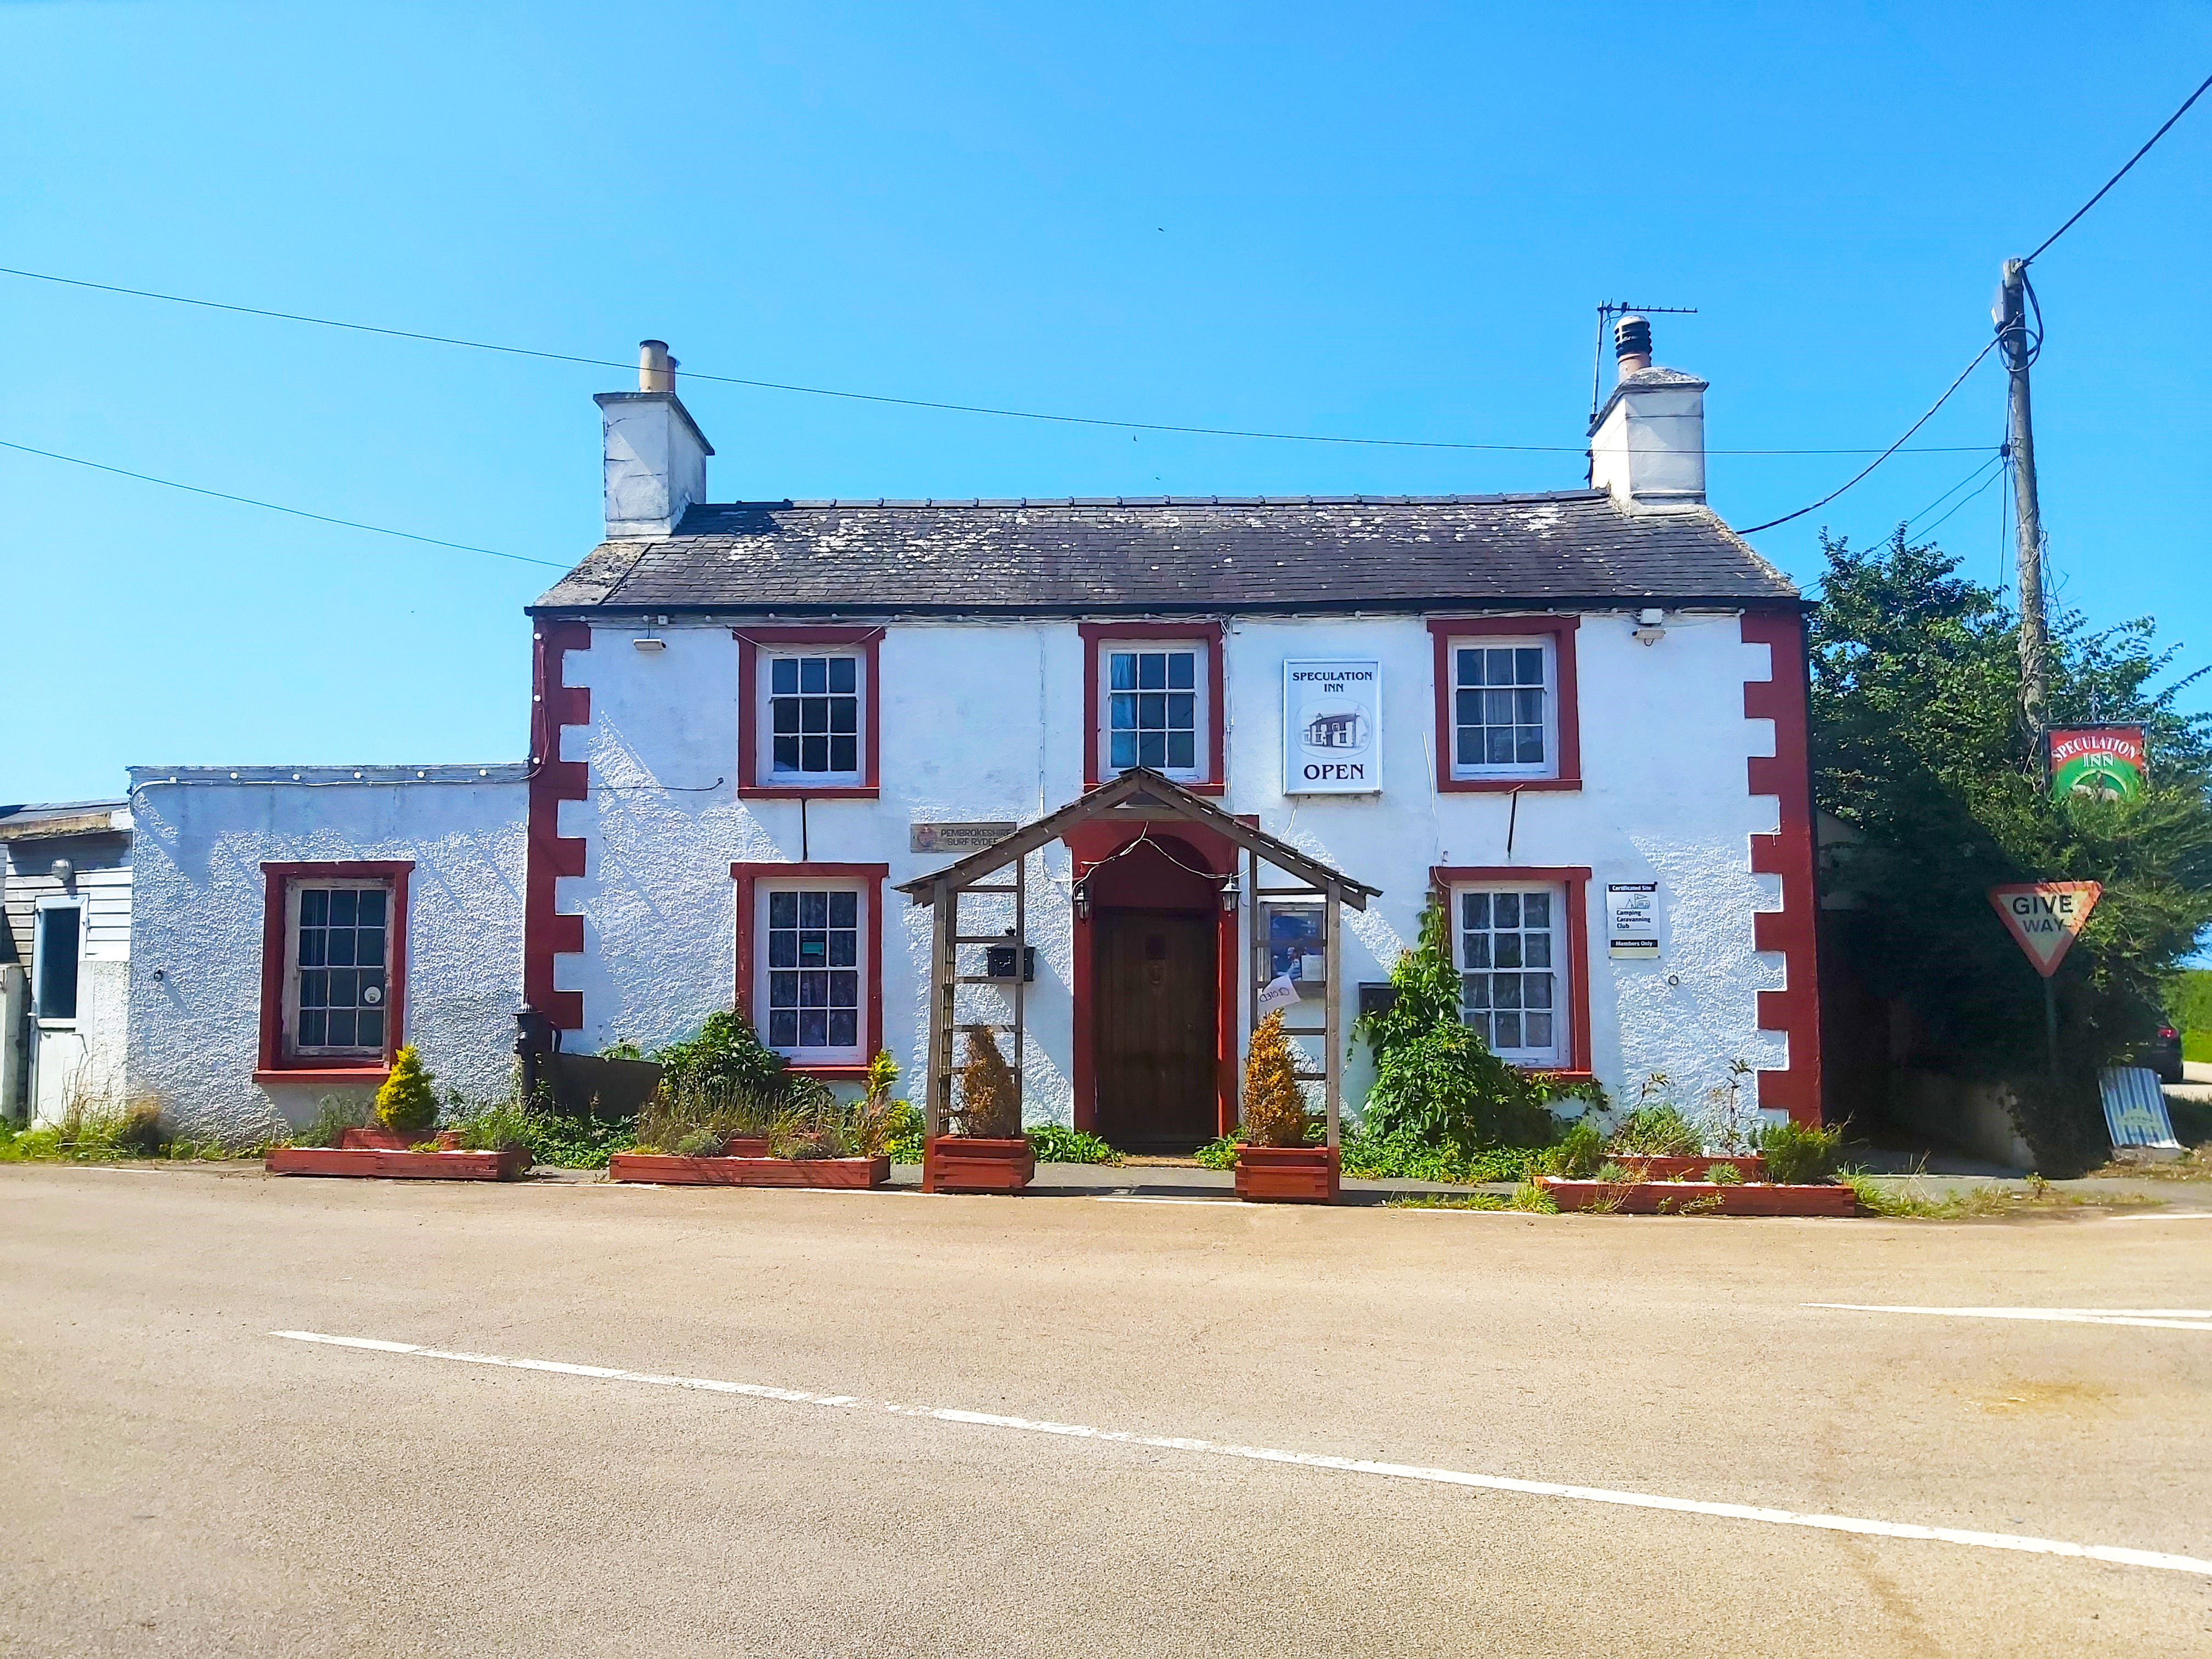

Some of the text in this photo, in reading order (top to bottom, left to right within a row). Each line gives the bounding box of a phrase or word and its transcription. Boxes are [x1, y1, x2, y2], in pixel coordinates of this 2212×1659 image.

[1293, 672, 1373, 681] SPECULATION
[1324, 684, 1344, 692] INN
[2051, 736, 2138, 762] SPECULATION
[1304, 764, 1364, 780] OPEN
[2013, 895, 2073, 915] GIVE
[2023, 918, 2064, 932] WAY
